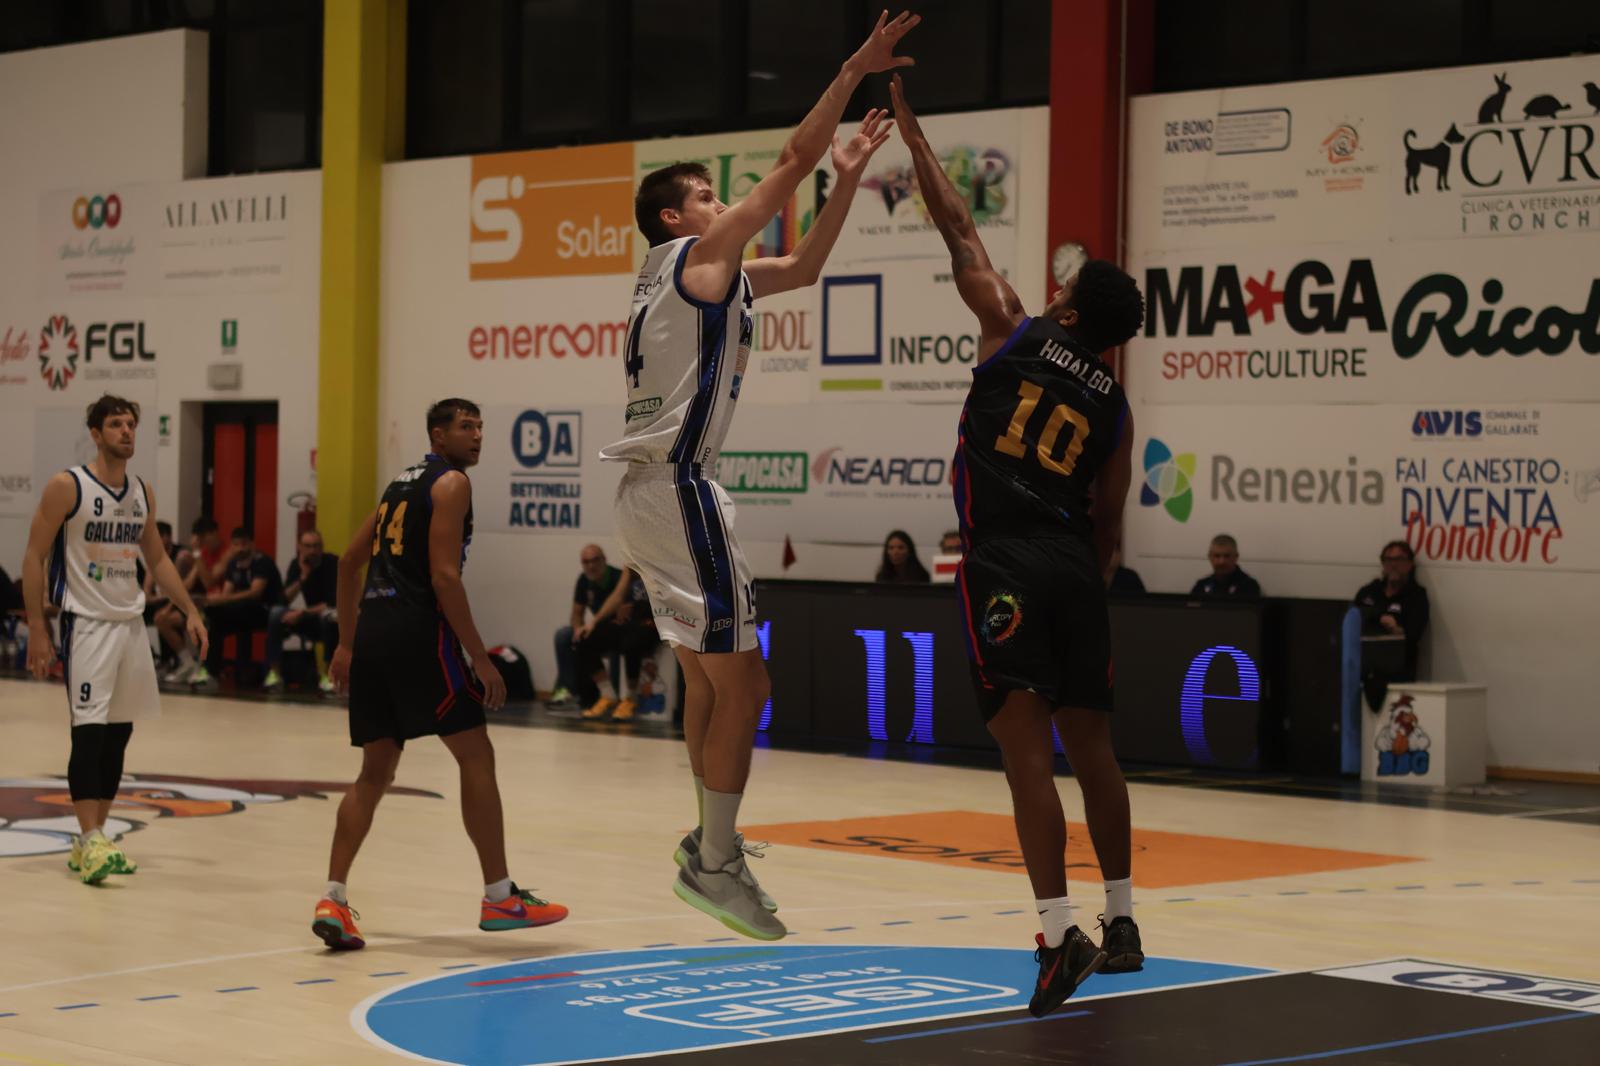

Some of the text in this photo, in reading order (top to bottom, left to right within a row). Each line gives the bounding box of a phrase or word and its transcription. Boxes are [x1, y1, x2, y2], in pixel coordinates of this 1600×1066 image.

[1461, 124, 1600, 188] CVR
[556, 215, 632, 259] Solar
[85, 321, 155, 362] FGL
[1039, 338, 1113, 395] HIDALGO
[1162, 349, 1367, 379] SPORTCULTURE
[993, 379, 1090, 477] 10
[1412, 411, 1483, 436] AVIS
[829, 458, 945, 486] NEARCO
[1211, 455, 1384, 505] Renexia
[1396, 459, 1427, 483] FAI
[94, 497, 103, 517] 9
[511, 482, 581, 498] BETTINELLI
[509, 502, 581, 529] ACCIAI
[1401, 487, 1560, 529] DIVENTA
[1404, 511, 1563, 563] Donatore
[80, 683, 91, 702] 9
